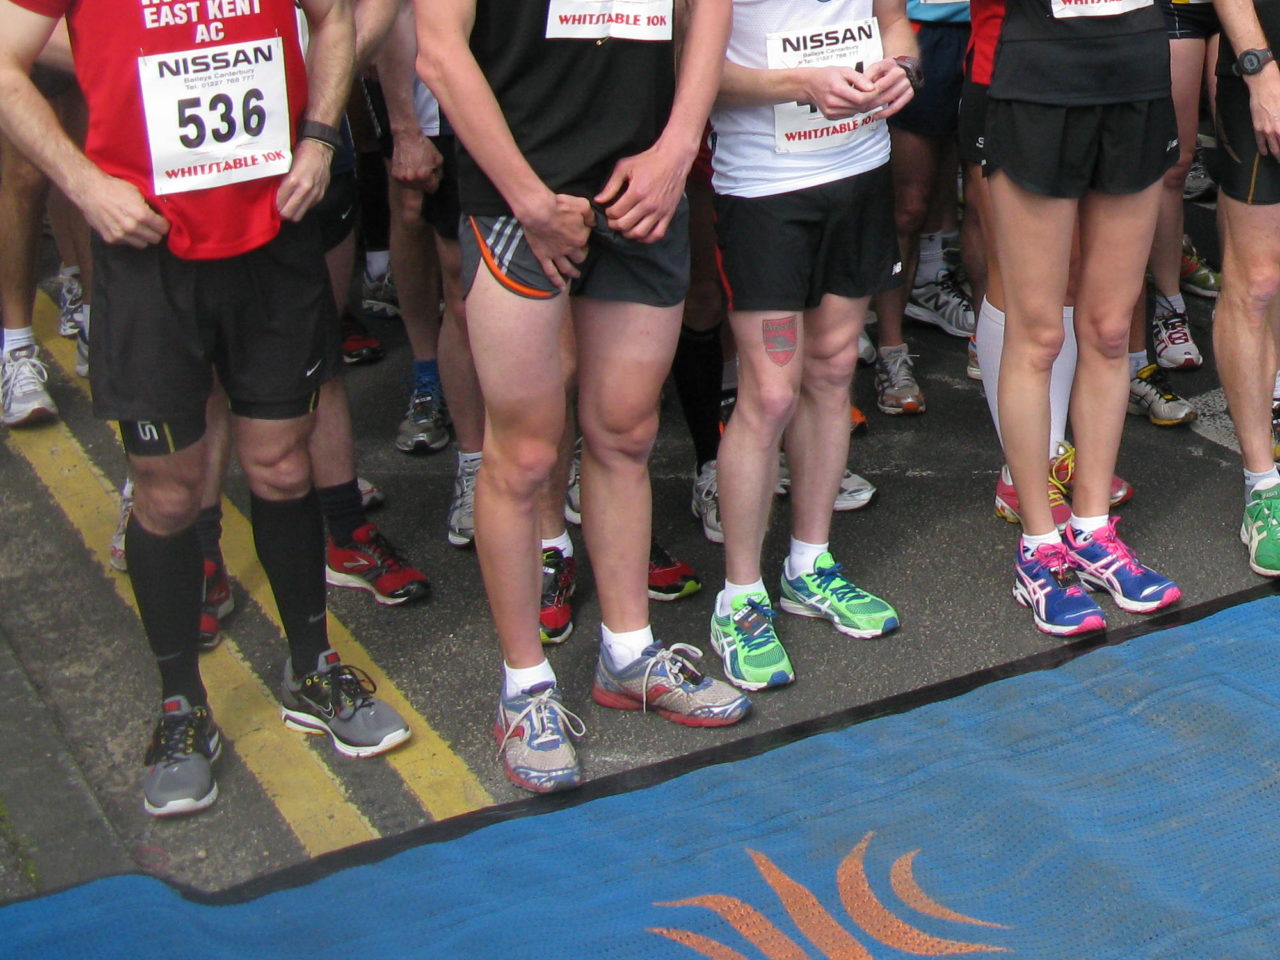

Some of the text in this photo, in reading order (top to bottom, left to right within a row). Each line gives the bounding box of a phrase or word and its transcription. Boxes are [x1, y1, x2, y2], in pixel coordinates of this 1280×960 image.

[143, 1, 200, 29] EAST
[558, 12, 667, 27] WHITSTABLE 10K
[195, 21, 225, 44] AC
[782, 24, 873, 53] NISSAN
[157, 44, 273, 79] NISSAN
[214, 68, 255, 79] Canterbury
[176, 87, 267, 149] 536
[785, 118, 860, 142] WHITSTABLE
[165, 149, 286, 180] WHITSTABLE 10K
